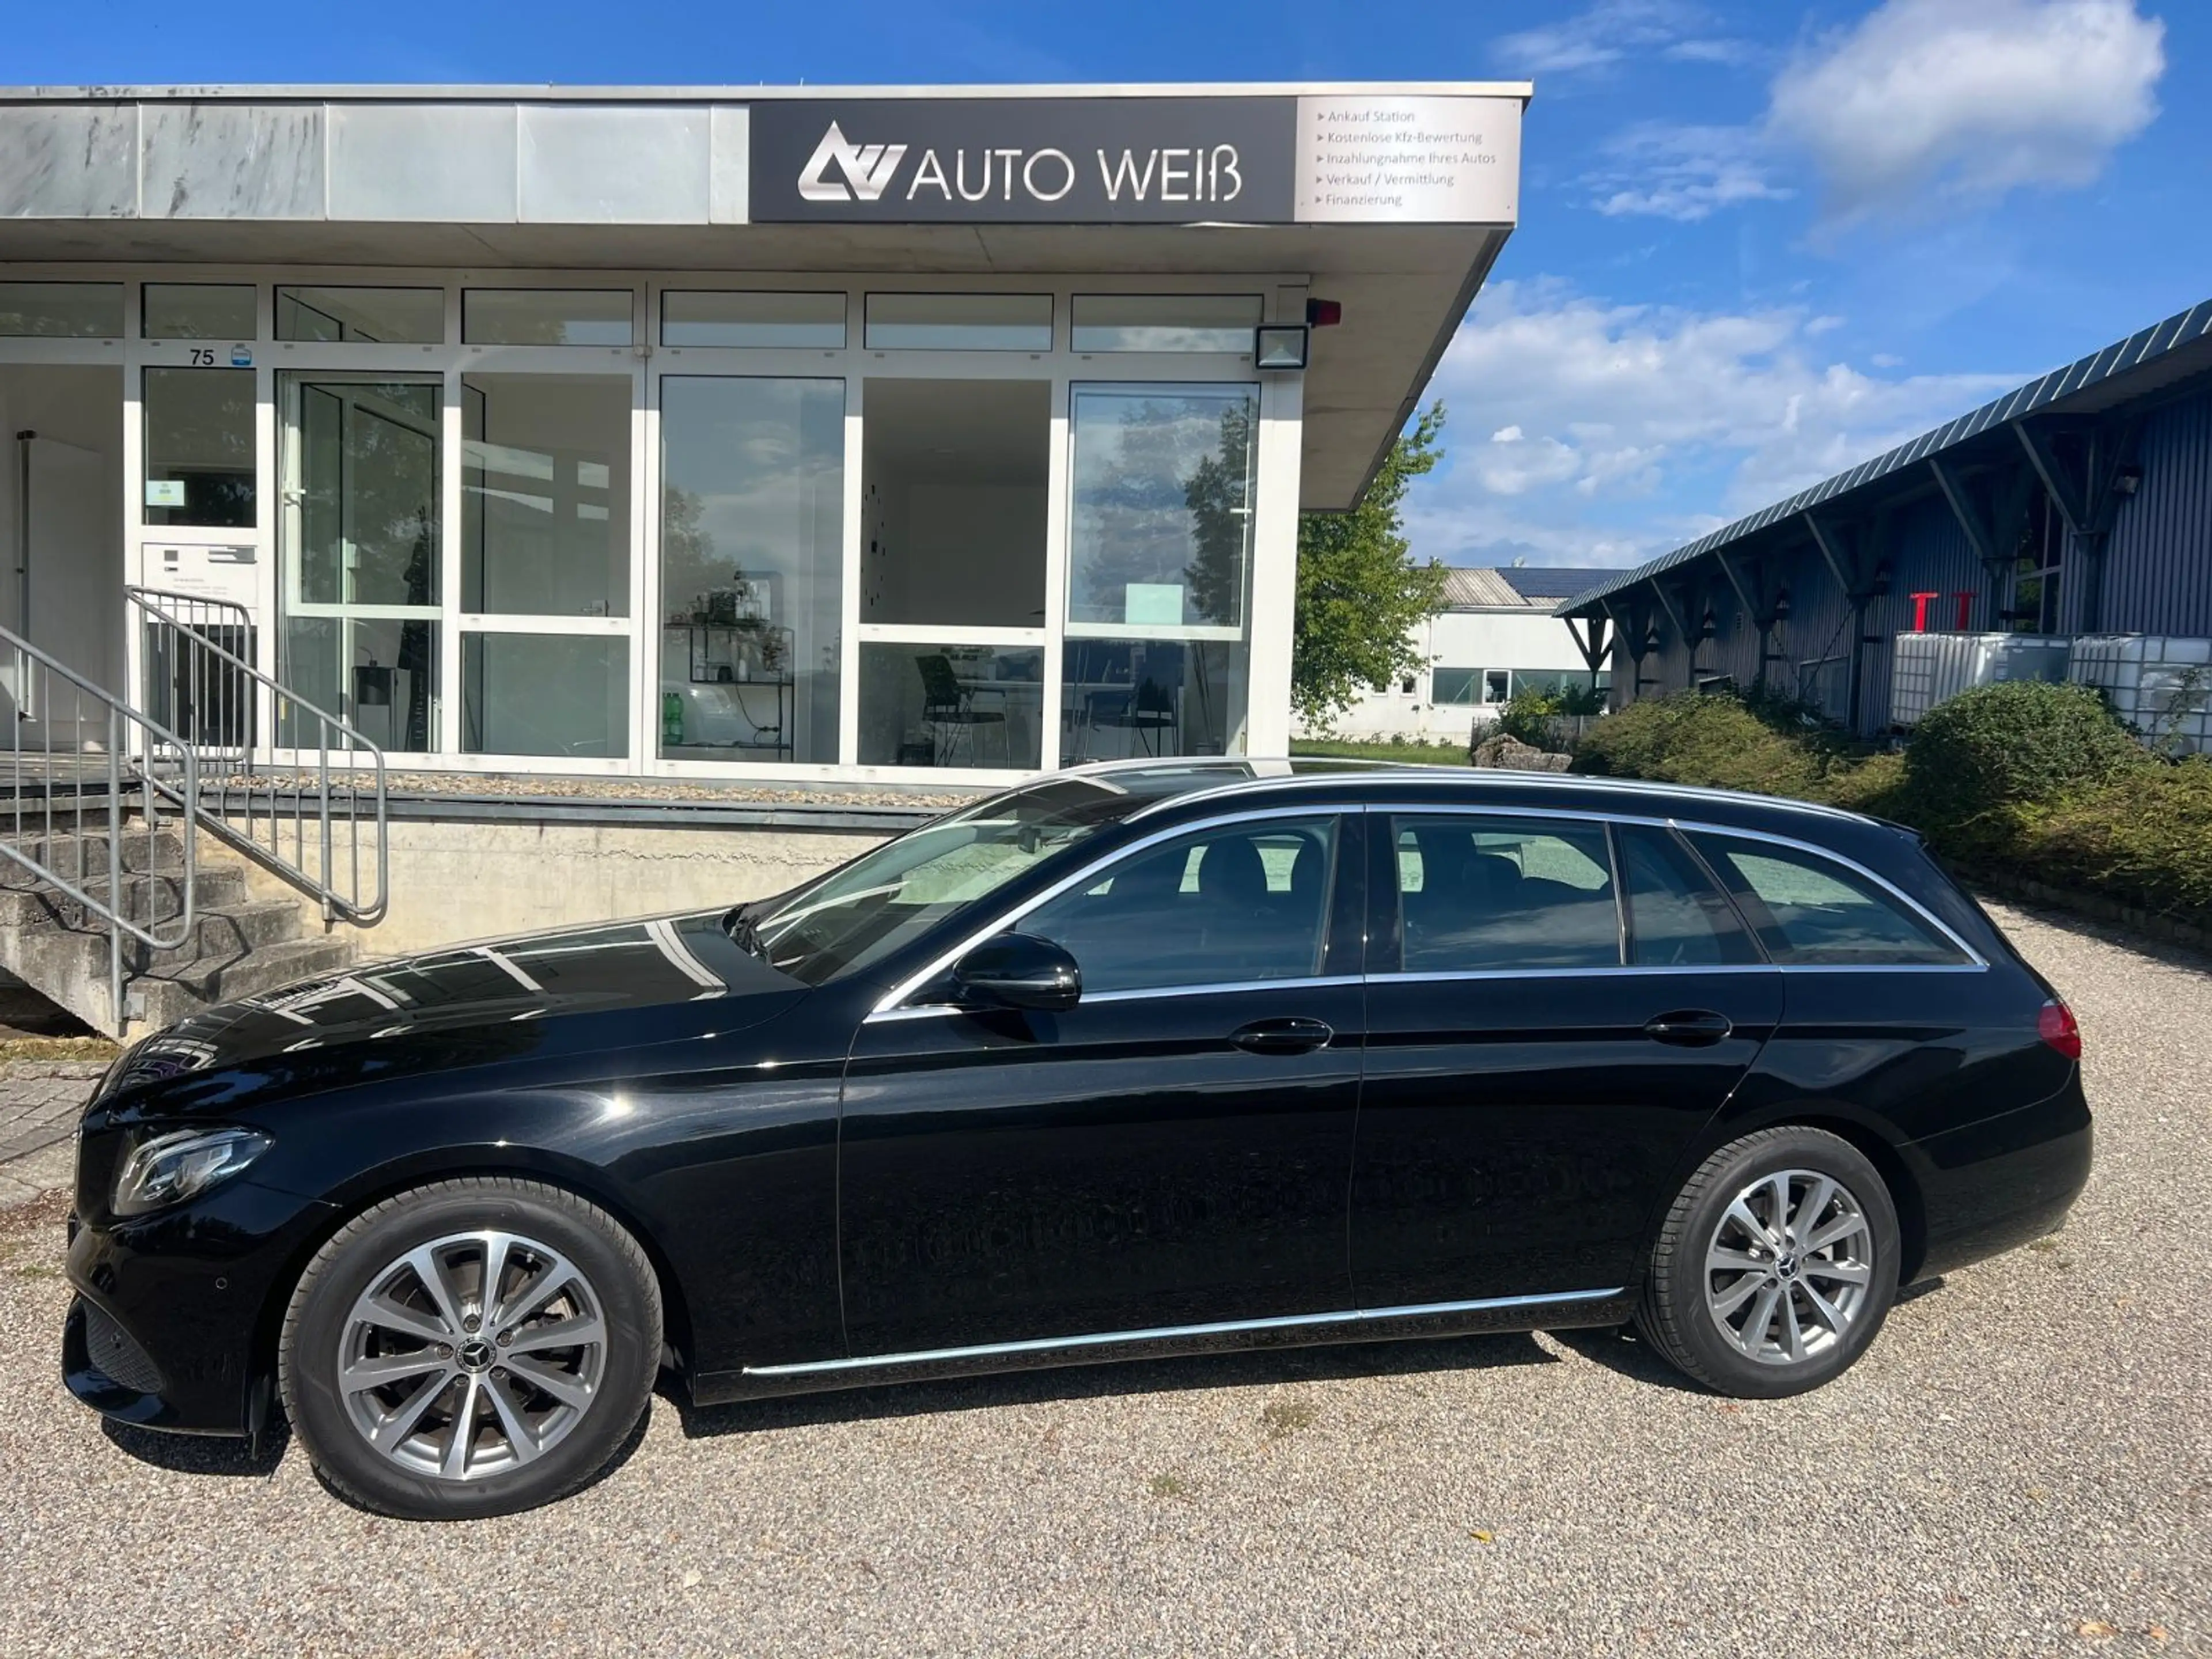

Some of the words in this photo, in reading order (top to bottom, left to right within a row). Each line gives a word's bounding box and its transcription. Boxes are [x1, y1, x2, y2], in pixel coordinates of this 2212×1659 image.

[1328, 111, 1370, 122] Ankauf
[1373, 111, 1415, 122] Station
[1328, 132, 1392, 143] Kostenlose
[1395, 132, 1483, 145] Kfz-Bewertung
[1327, 153, 1425, 166] Inzahlungnahme
[1429, 153, 1458, 164] Ihres
[1461, 153, 1496, 164] Autos
[907, 148, 1074, 202] AUTO
[1097, 143, 1242, 202] WEIß
[1327, 174, 1372, 185] Verkauf
[1374, 174, 1380, 186] /
[1384, 174, 1455, 187] Vermittlung
[1325, 194, 1403, 207] Finanzierung
[190, 350, 214, 365] 75
